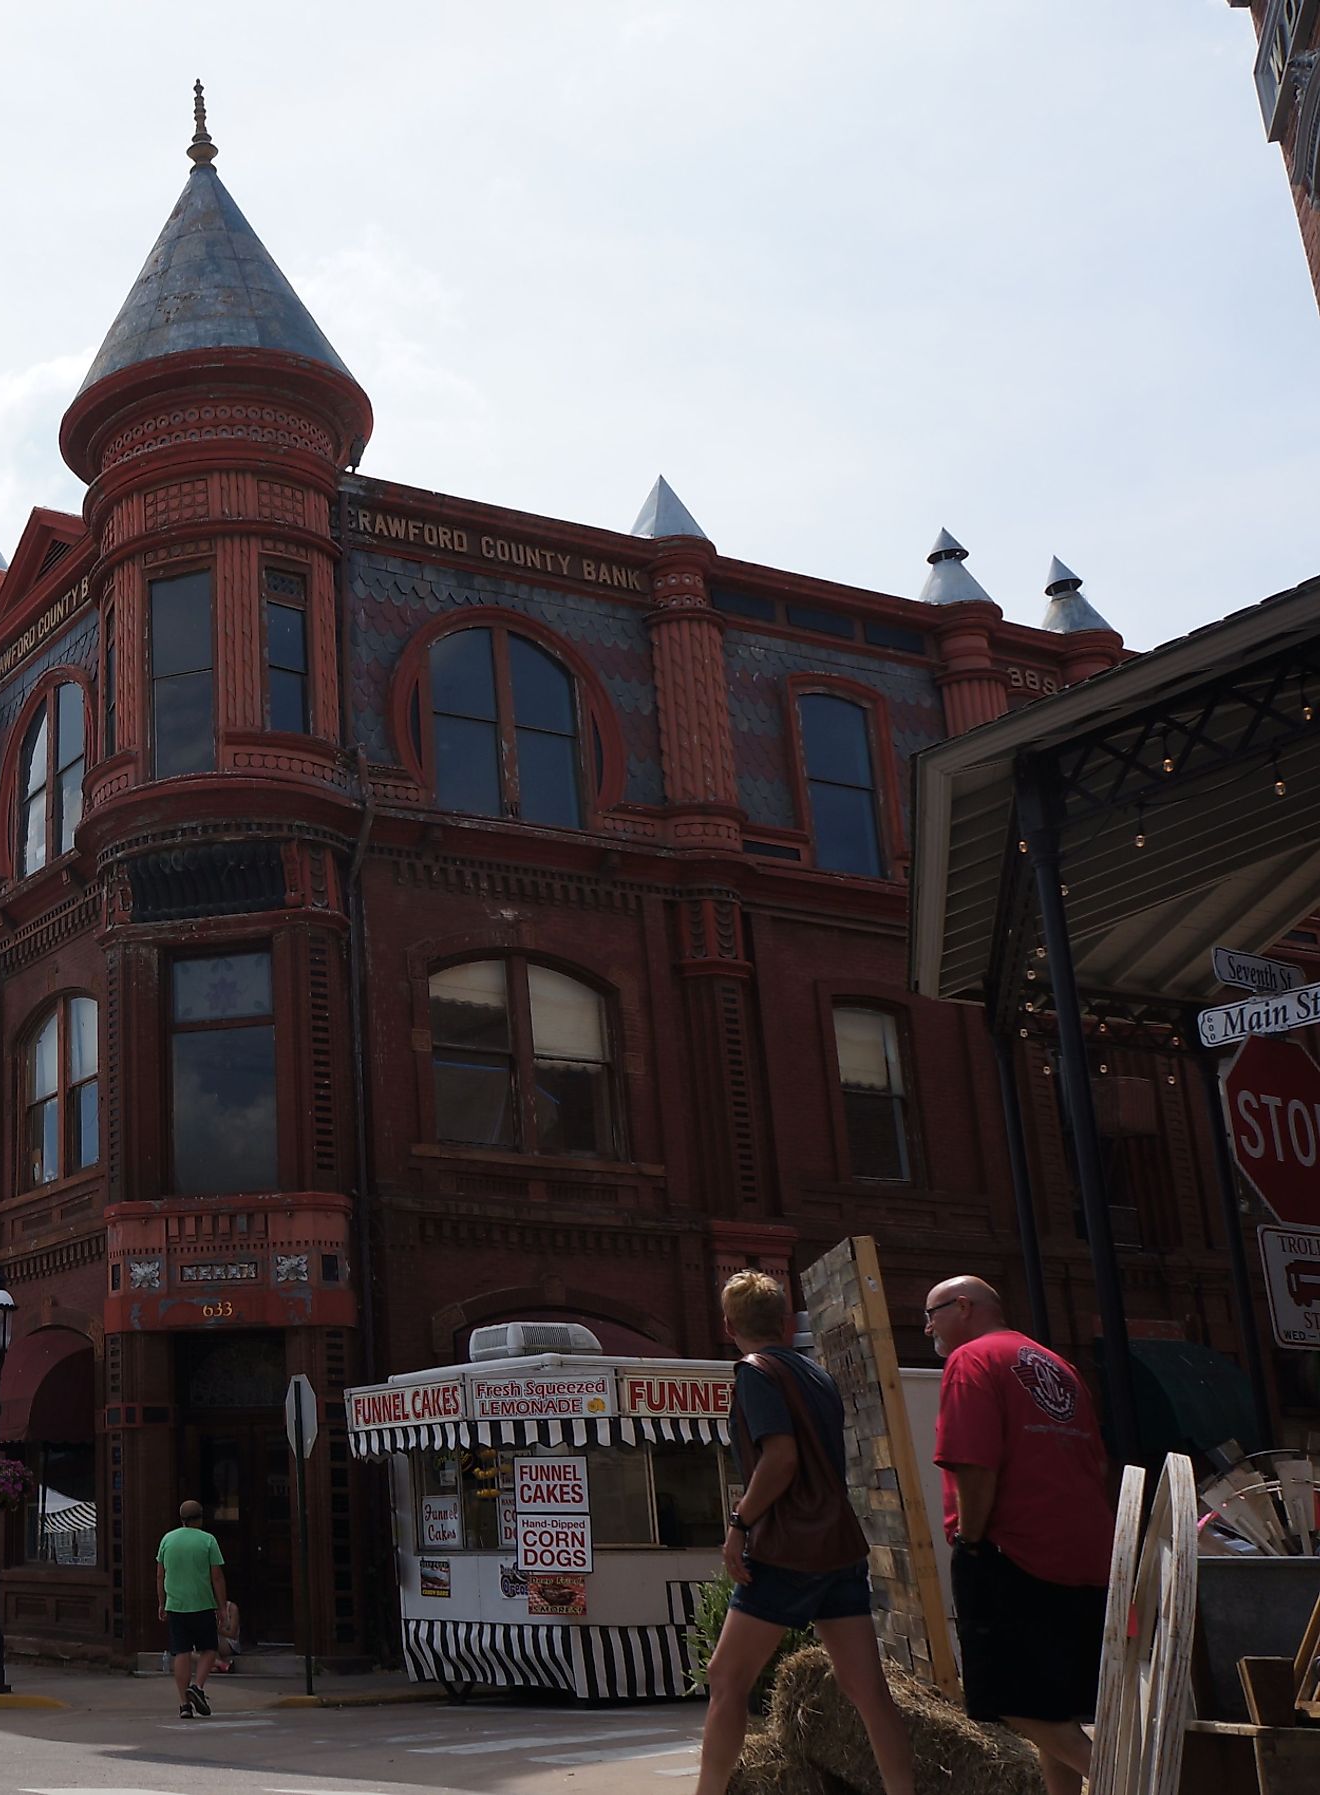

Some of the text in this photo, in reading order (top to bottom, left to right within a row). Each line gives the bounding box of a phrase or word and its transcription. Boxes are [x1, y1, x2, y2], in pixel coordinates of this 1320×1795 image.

[481, 536, 571, 575] COUNTY
[582, 558, 641, 591] BANK
[38, 585, 79, 638] COUNTY
[1228, 955, 1292, 990] Seventh St
[1222, 1001, 1289, 1037] Main
[1237, 1089, 1320, 1167] STO
[1278, 1235, 1320, 1256] TROL
[202, 1301, 233, 1317] 633
[476, 1379, 605, 1398] Fresh Squeezed
[630, 1380, 731, 1413] FUNNE
[354, 1385, 460, 1425] FUNNEL CAKES
[481, 1400, 582, 1415] LEMONADE
[519, 1464, 582, 1482] FUNNEL
[520, 1484, 583, 1504] CAKES
[424, 1503, 458, 1522] Funnel
[428, 1524, 457, 1541] Cakes
[522, 1520, 586, 1531] Hand-Dipped
[522, 1530, 586, 1548] CORN
[523, 1549, 587, 1567] DOGS
